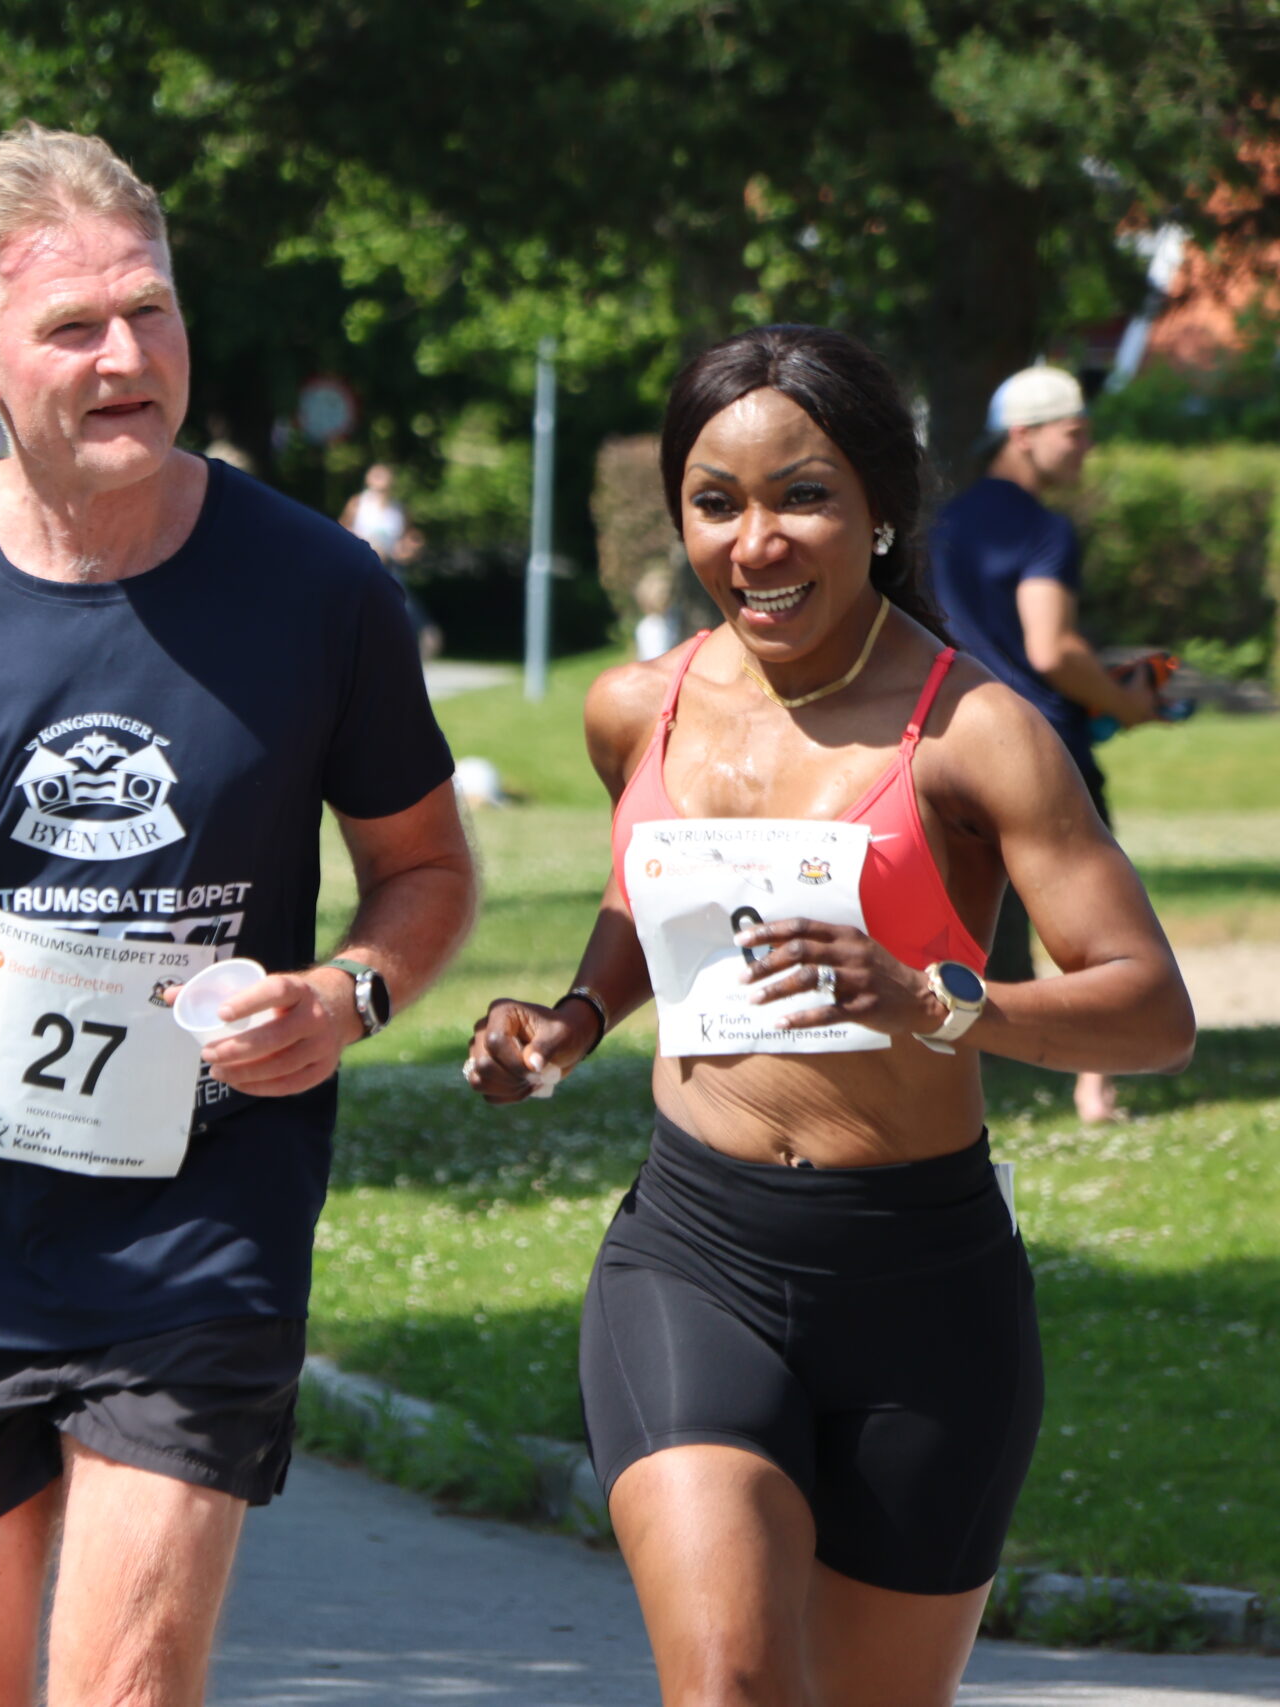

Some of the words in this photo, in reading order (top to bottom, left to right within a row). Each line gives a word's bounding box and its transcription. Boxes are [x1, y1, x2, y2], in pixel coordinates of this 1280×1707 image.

[38, 713, 153, 745] KONGSVINGER
[28, 821, 98, 853] BYEN
[110, 821, 162, 853] VÅR
[0, 921, 155, 966] SENTRUMSGATELØPET
[158, 952, 191, 968] 2025
[8, 960, 125, 995] Bedriftsidretten
[21, 1011, 129, 1097] 27
[12, 1136, 146, 1168] Konsulenttjenester
